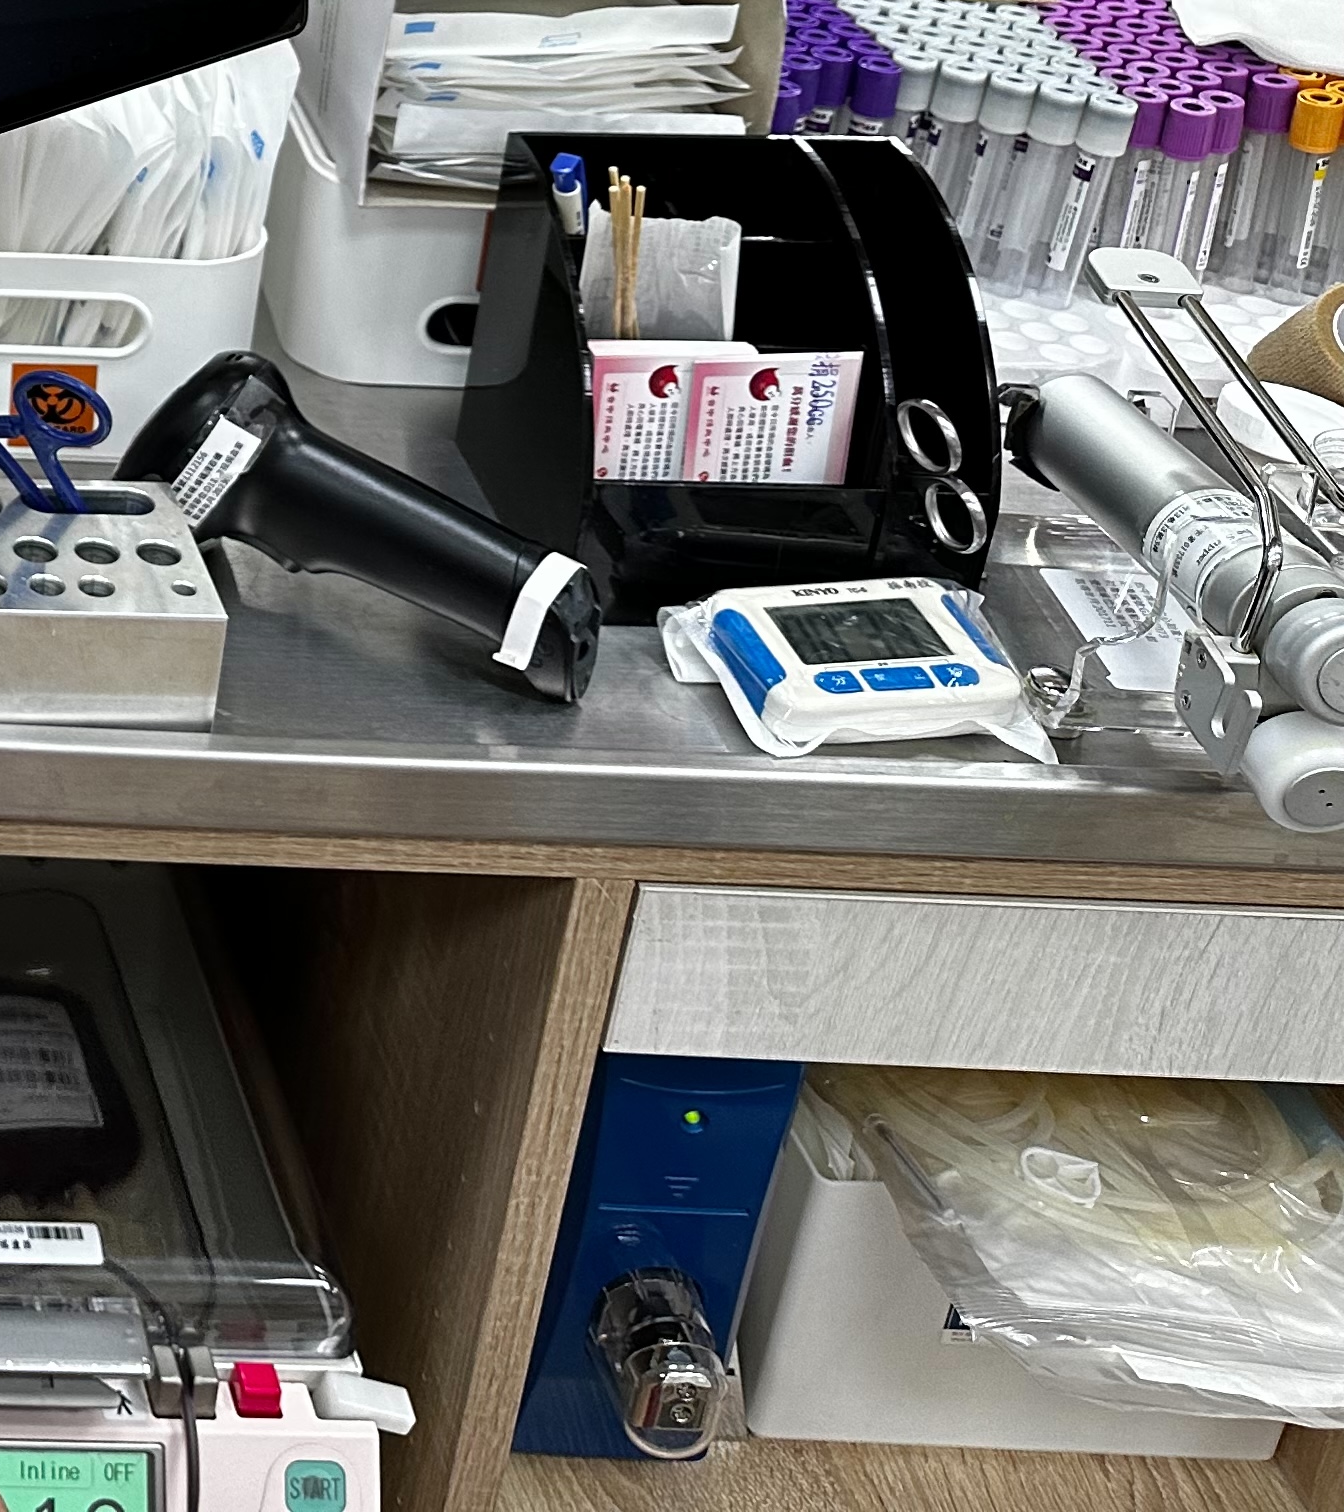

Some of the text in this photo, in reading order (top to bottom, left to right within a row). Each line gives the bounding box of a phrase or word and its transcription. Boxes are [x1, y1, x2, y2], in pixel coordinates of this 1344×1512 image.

[792, 587, 840, 597] KINYO
[19, 1460, 80, 1481] Inline
[103, 1462, 137, 1482] OFF
[289, 1476, 342, 1501] START
